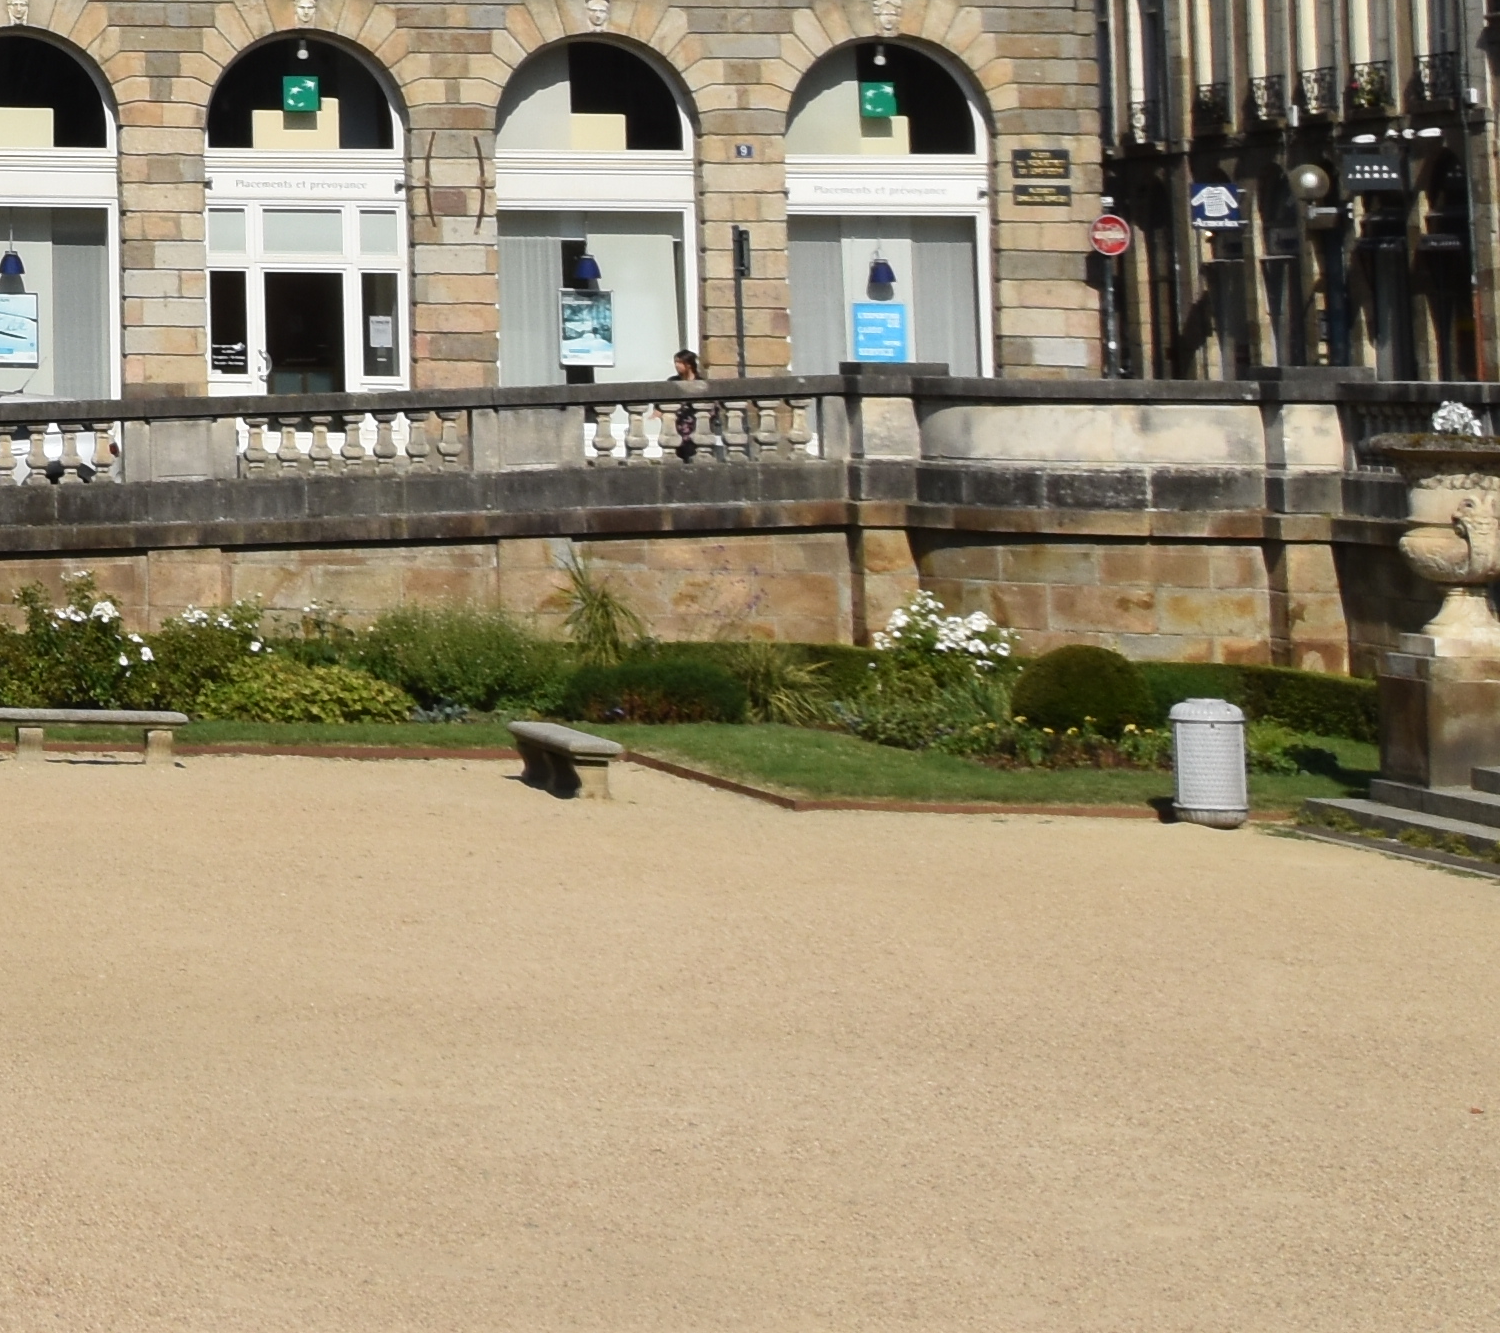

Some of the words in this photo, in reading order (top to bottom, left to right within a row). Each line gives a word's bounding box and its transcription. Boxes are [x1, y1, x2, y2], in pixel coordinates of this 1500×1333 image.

[740, 145, 748, 156] 9
[235, 179, 292, 189] Placements
[296, 181, 306, 189] et
[309, 181, 367, 191] prévoyance
